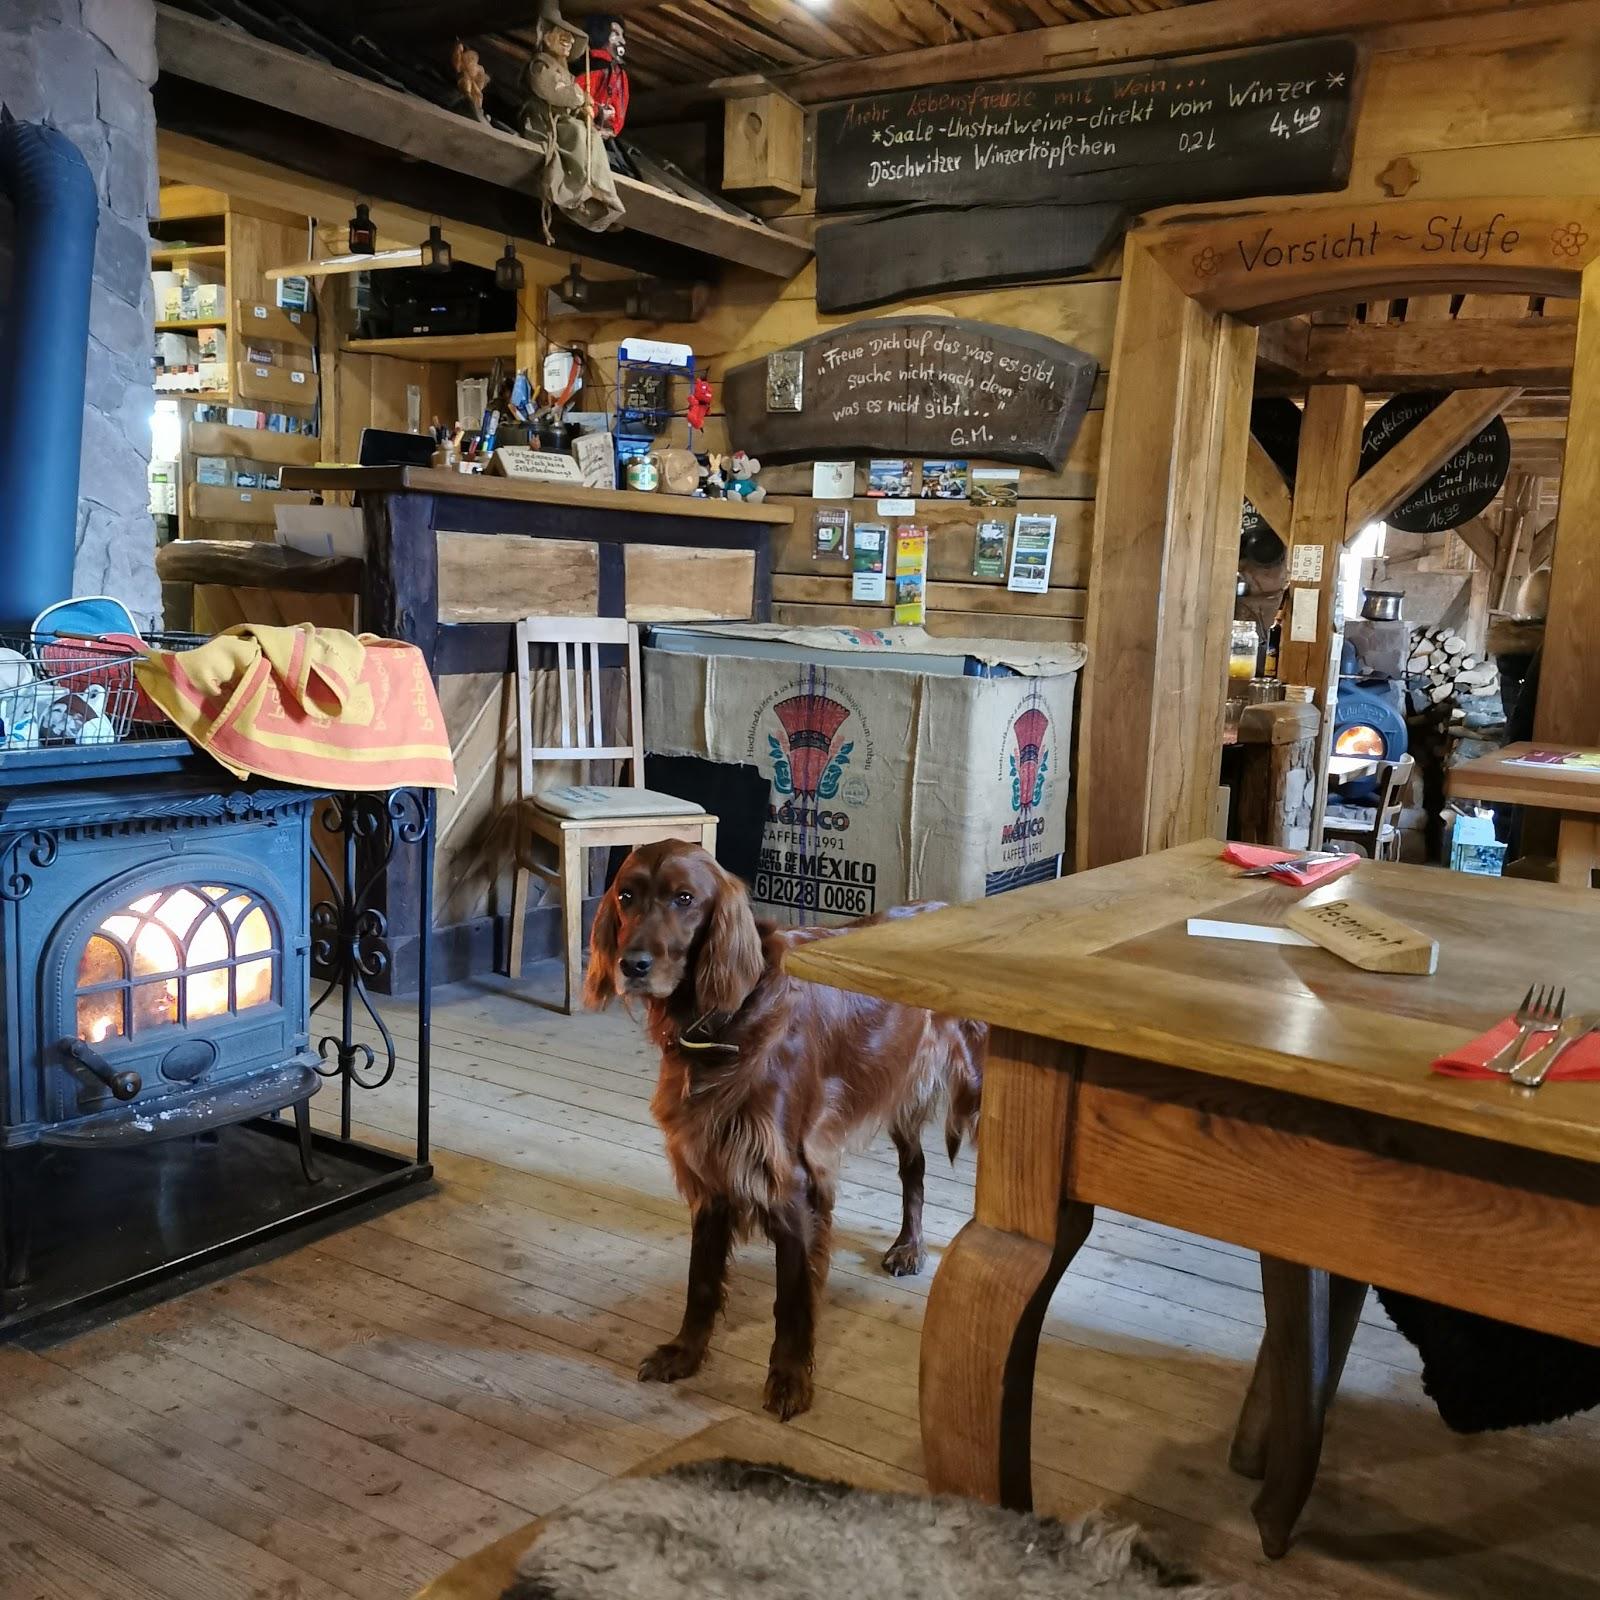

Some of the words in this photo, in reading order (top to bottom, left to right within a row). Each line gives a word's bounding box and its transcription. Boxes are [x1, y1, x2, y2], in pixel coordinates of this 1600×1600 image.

[1170, 99, 1213, 118] vom
[867, 147, 963, 187] Döschwitzer
[974, 133, 1116, 170] Winzertröpfchen
[1238, 220, 1380, 272] Vorsicht
[1421, 213, 1520, 260] Stufe
[869, 333, 900, 357] Dich
[903, 330, 933, 357] auf
[934, 334, 961, 354] das
[965, 345, 994, 364] was
[999, 355, 1020, 372] es
[847, 363, 893, 390] suche
[899, 365, 934, 382] nicht
[938, 370, 975, 388] nach
[979, 375, 1013, 397] dem
[832, 401, 861, 422] was
[866, 399, 883, 414] es
[888, 395, 920, 413] nicht
[785, 851, 798, 862] OF
[815, 836, 845, 851] 1991
[799, 852, 877, 884] MÉXICO
[774, 878, 815, 906] 2028
[824, 885, 867, 914] 0086
